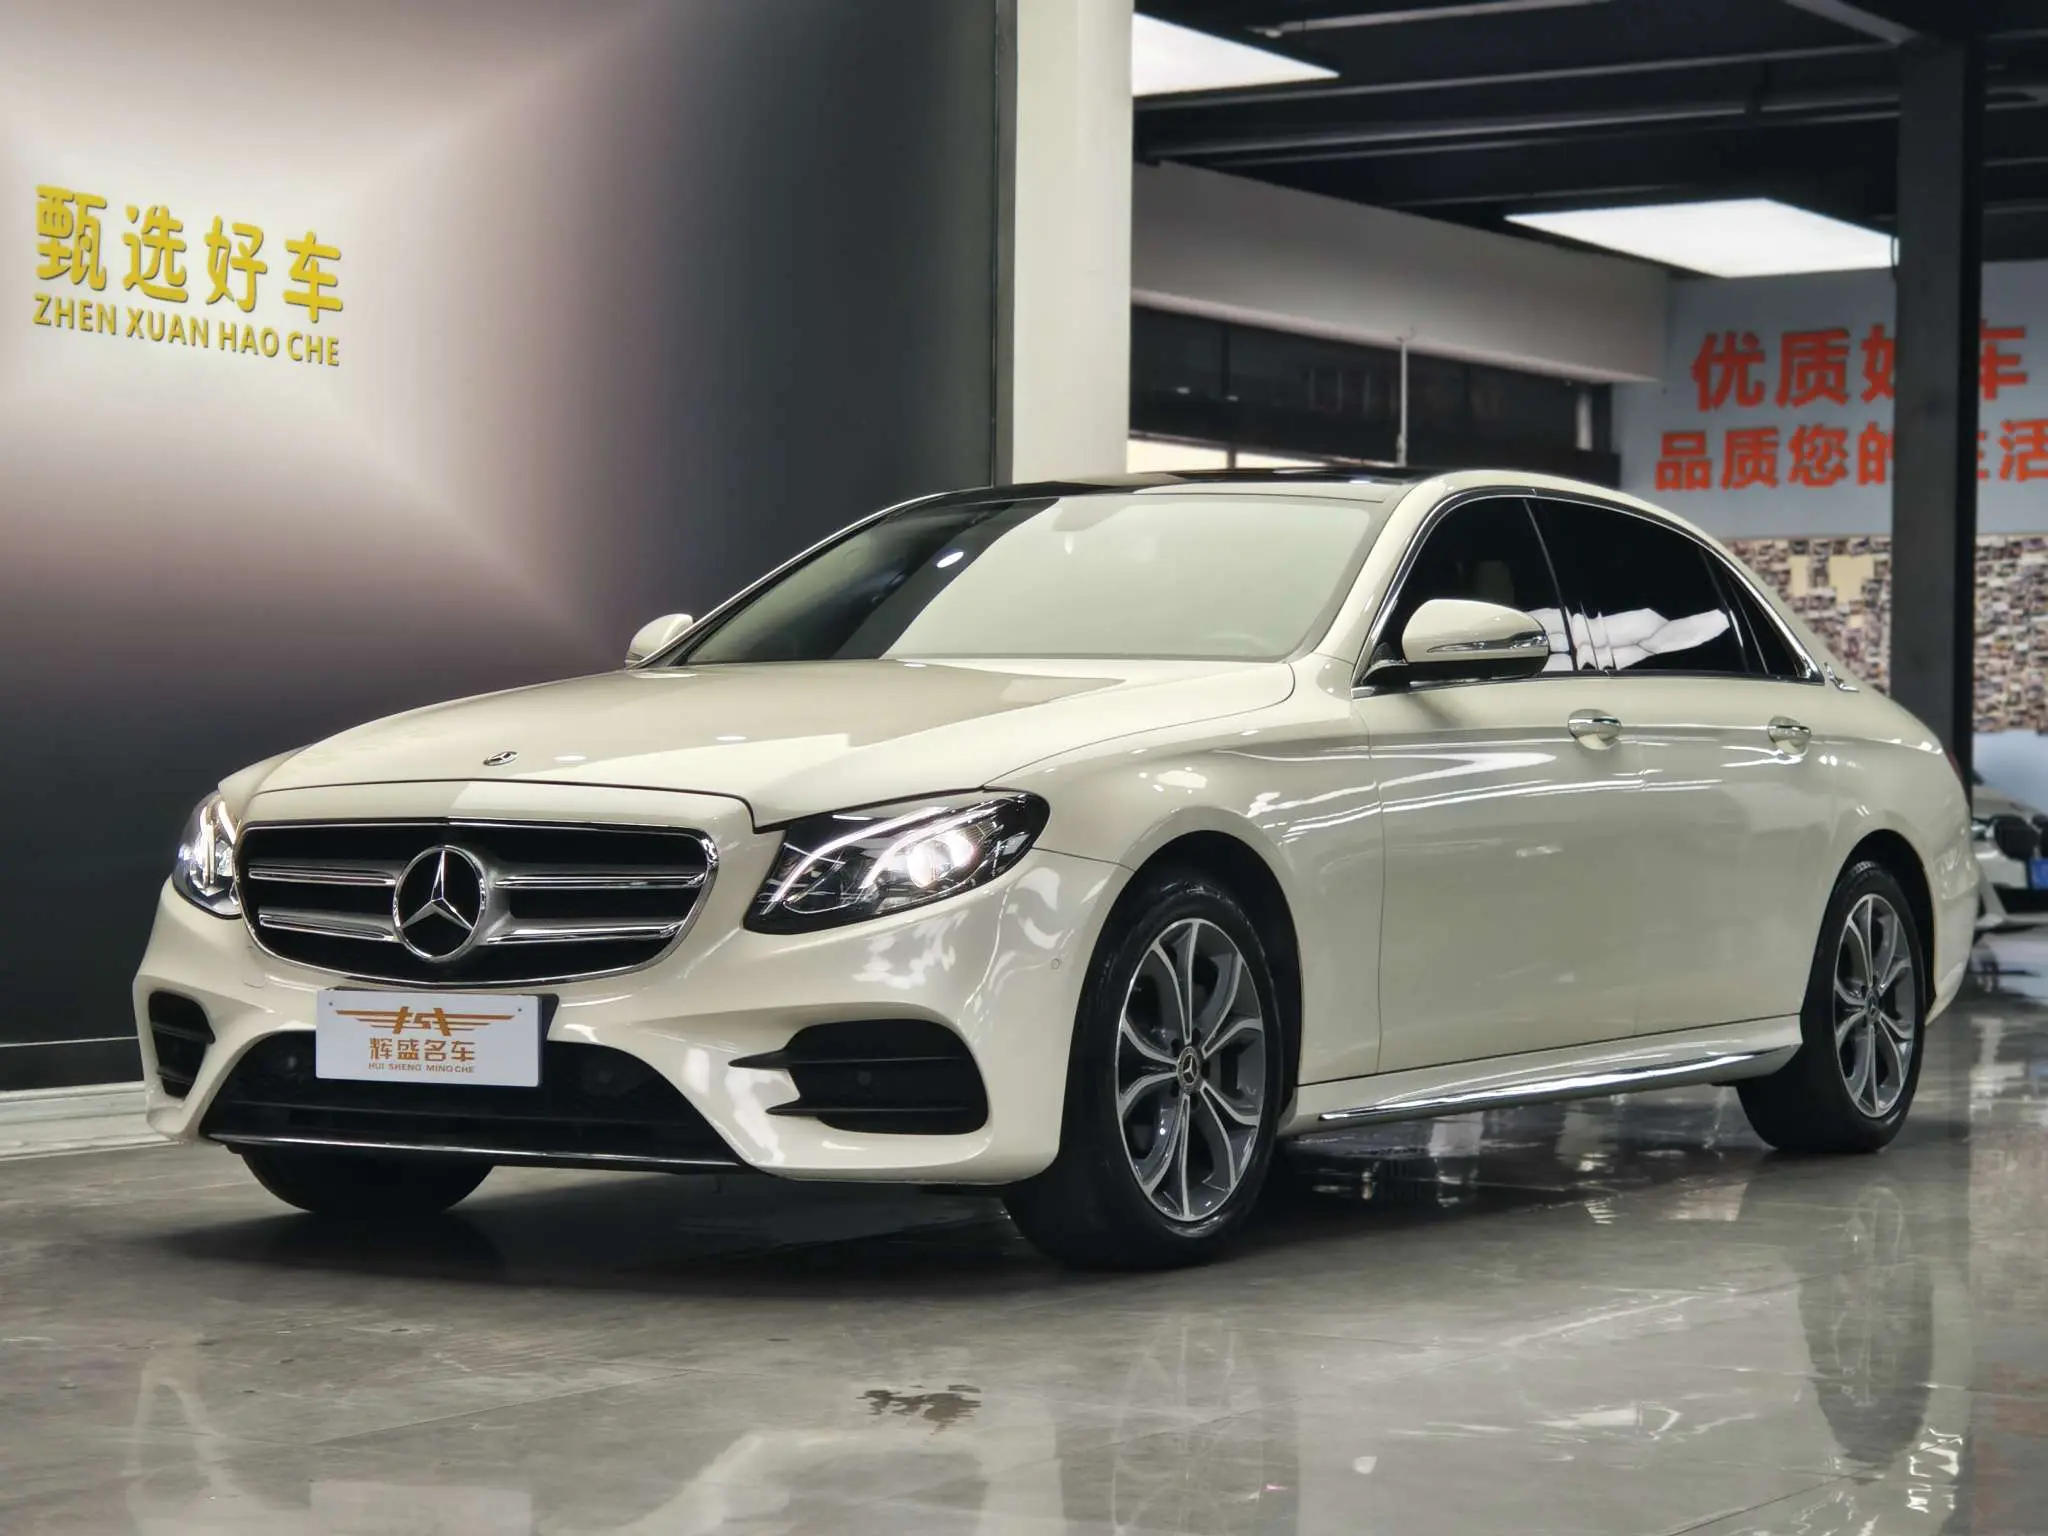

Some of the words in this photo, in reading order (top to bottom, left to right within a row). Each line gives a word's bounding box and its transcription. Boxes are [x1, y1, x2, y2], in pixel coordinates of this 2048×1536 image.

[36, 185, 343, 323] 甄选好车
[33, 293, 117, 335] ZHEN
[126, 307, 209, 348] XUAN
[218, 321, 279, 357] HAO
[287, 331, 340, 366] CHE
[369, 1037, 475, 1062] 辉盛名车
